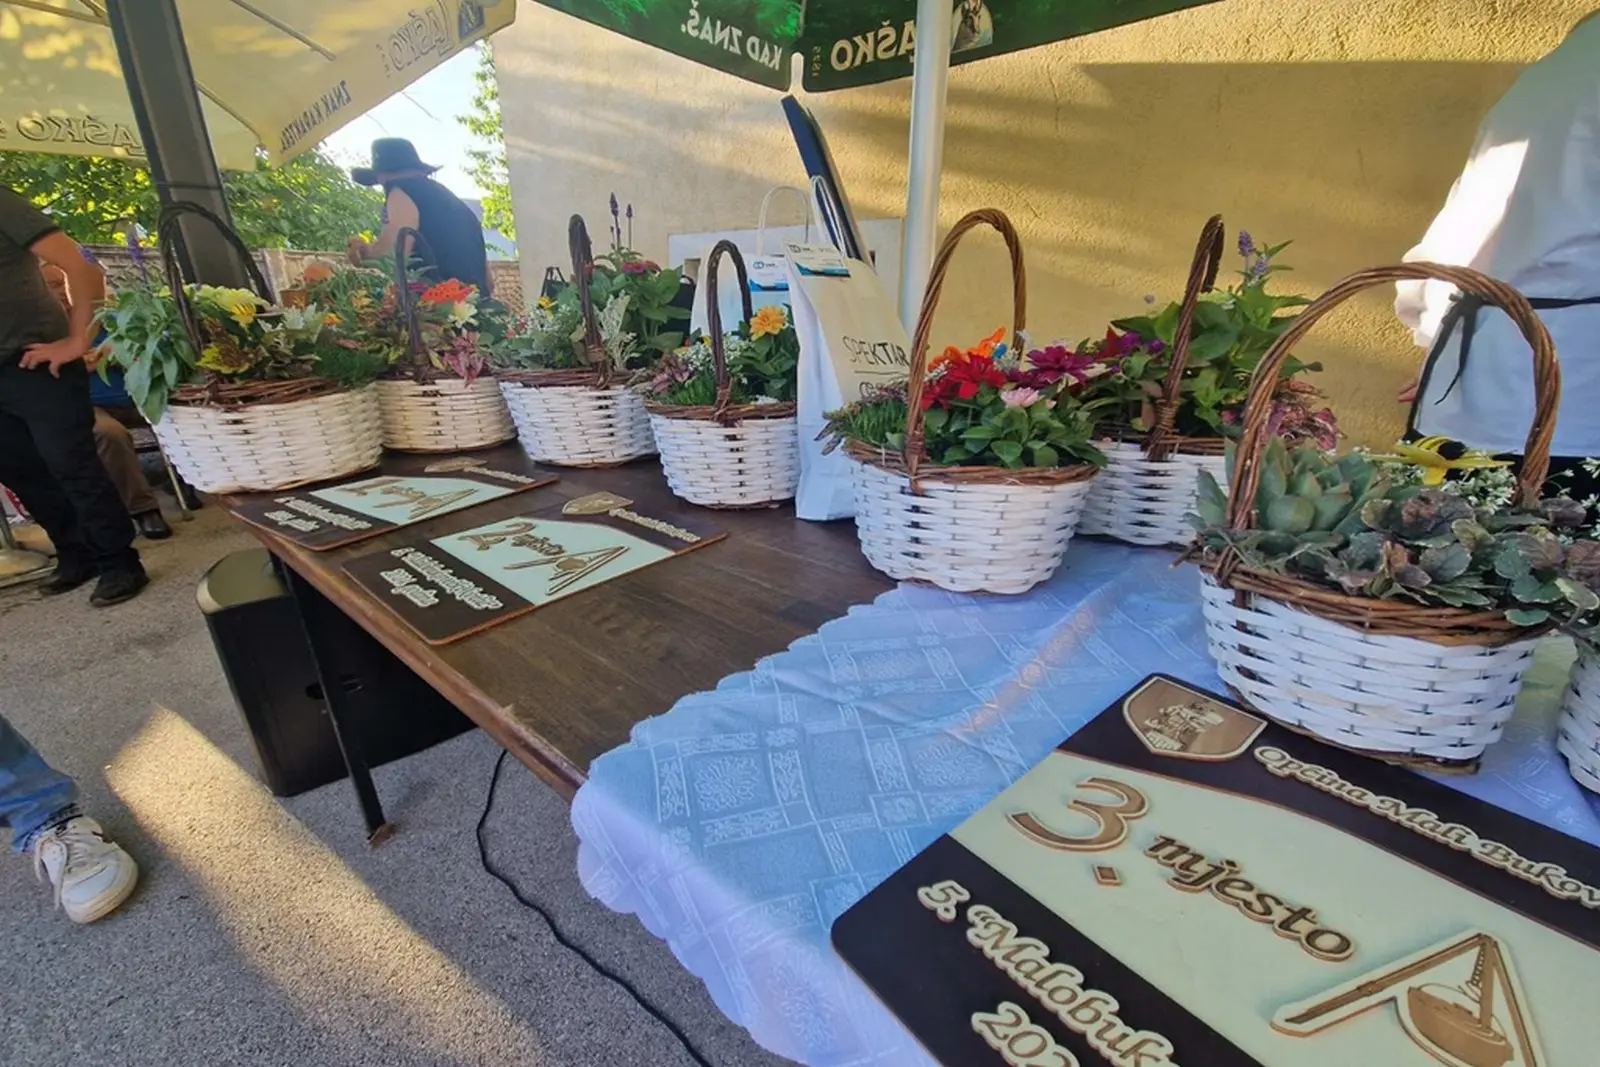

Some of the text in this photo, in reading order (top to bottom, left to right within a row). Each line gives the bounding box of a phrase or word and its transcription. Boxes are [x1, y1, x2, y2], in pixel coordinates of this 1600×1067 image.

[842, 335, 910, 367] SPEKTAR
[1006, 777, 1151, 886] 3.
[1376, 795, 1479, 851] Mali
[918, 880, 970, 921] 5.
[1144, 831, 1355, 960] mjesto
